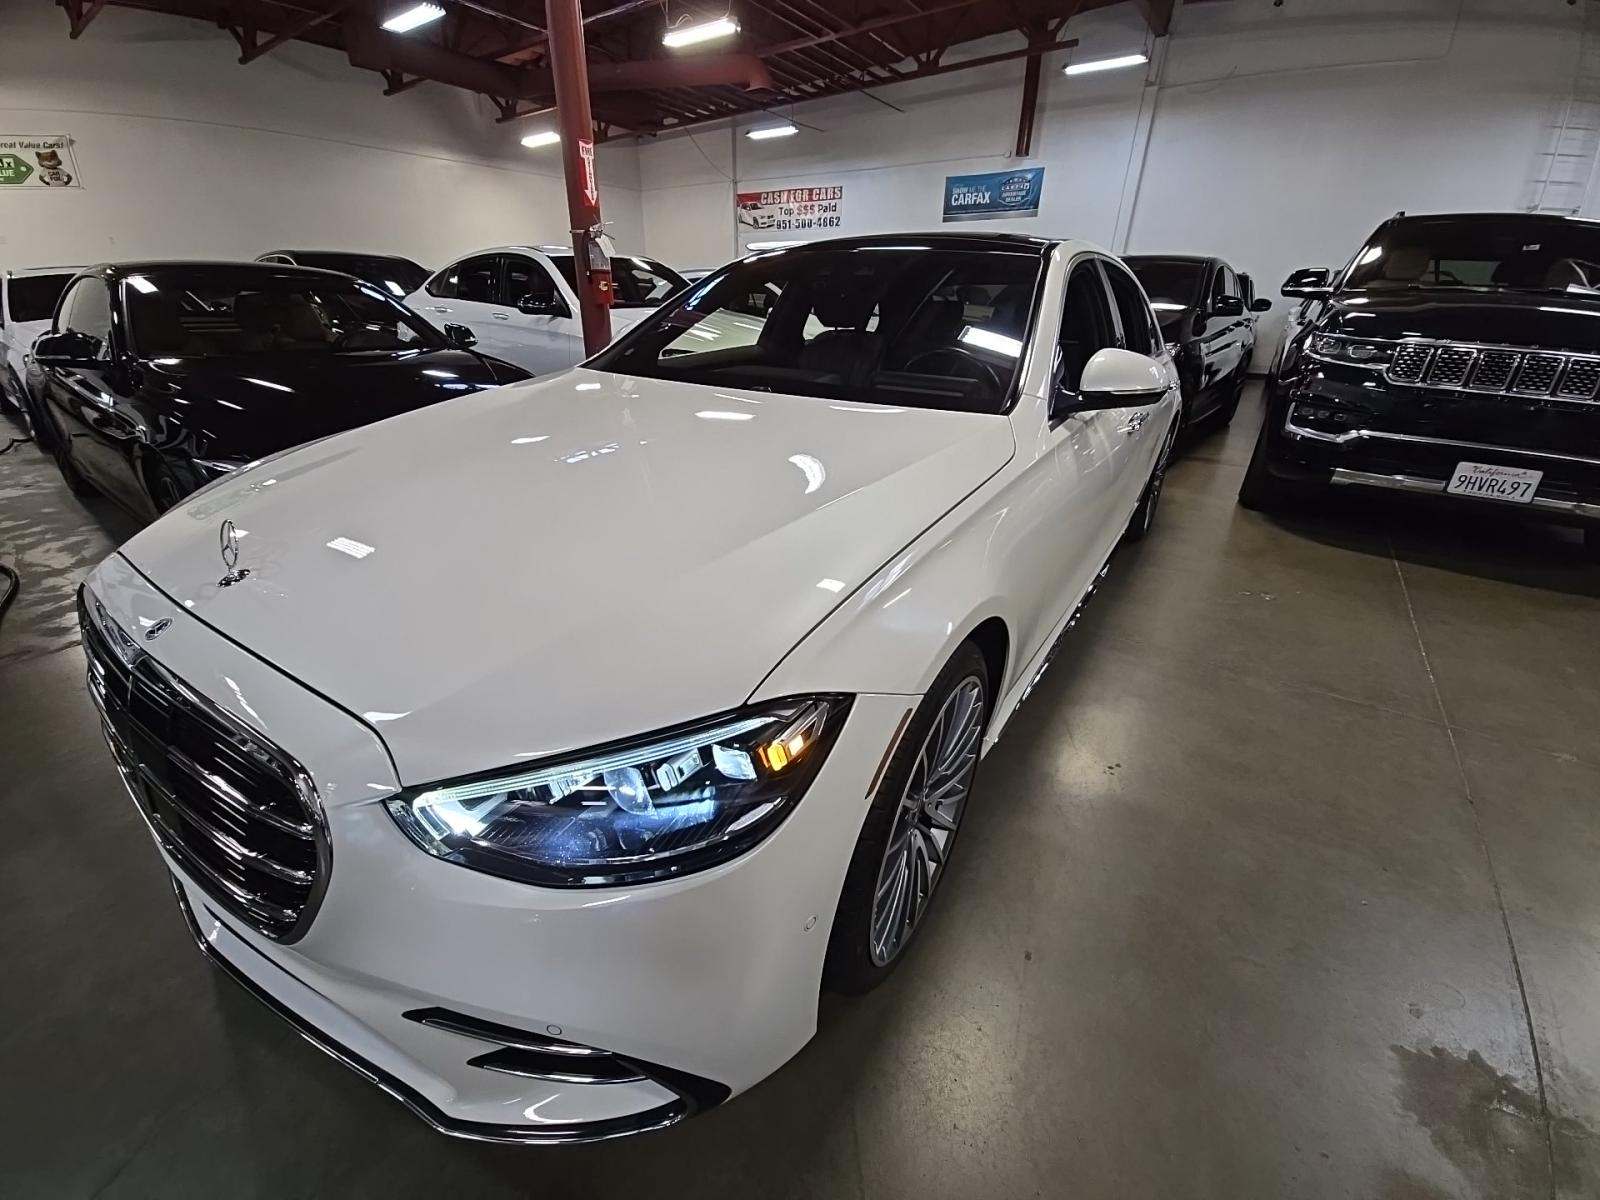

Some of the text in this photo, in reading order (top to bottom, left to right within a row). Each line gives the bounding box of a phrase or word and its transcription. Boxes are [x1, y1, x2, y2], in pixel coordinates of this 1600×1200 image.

[0, 141, 64, 149] reat Value Cars!
[761, 187, 842, 205] CASH FOR CARS
[952, 191, 991, 206] CARFAX
[778, 203, 837, 217] Top $$$ Paid
[1454, 475, 1532, 497] 9HVR497
